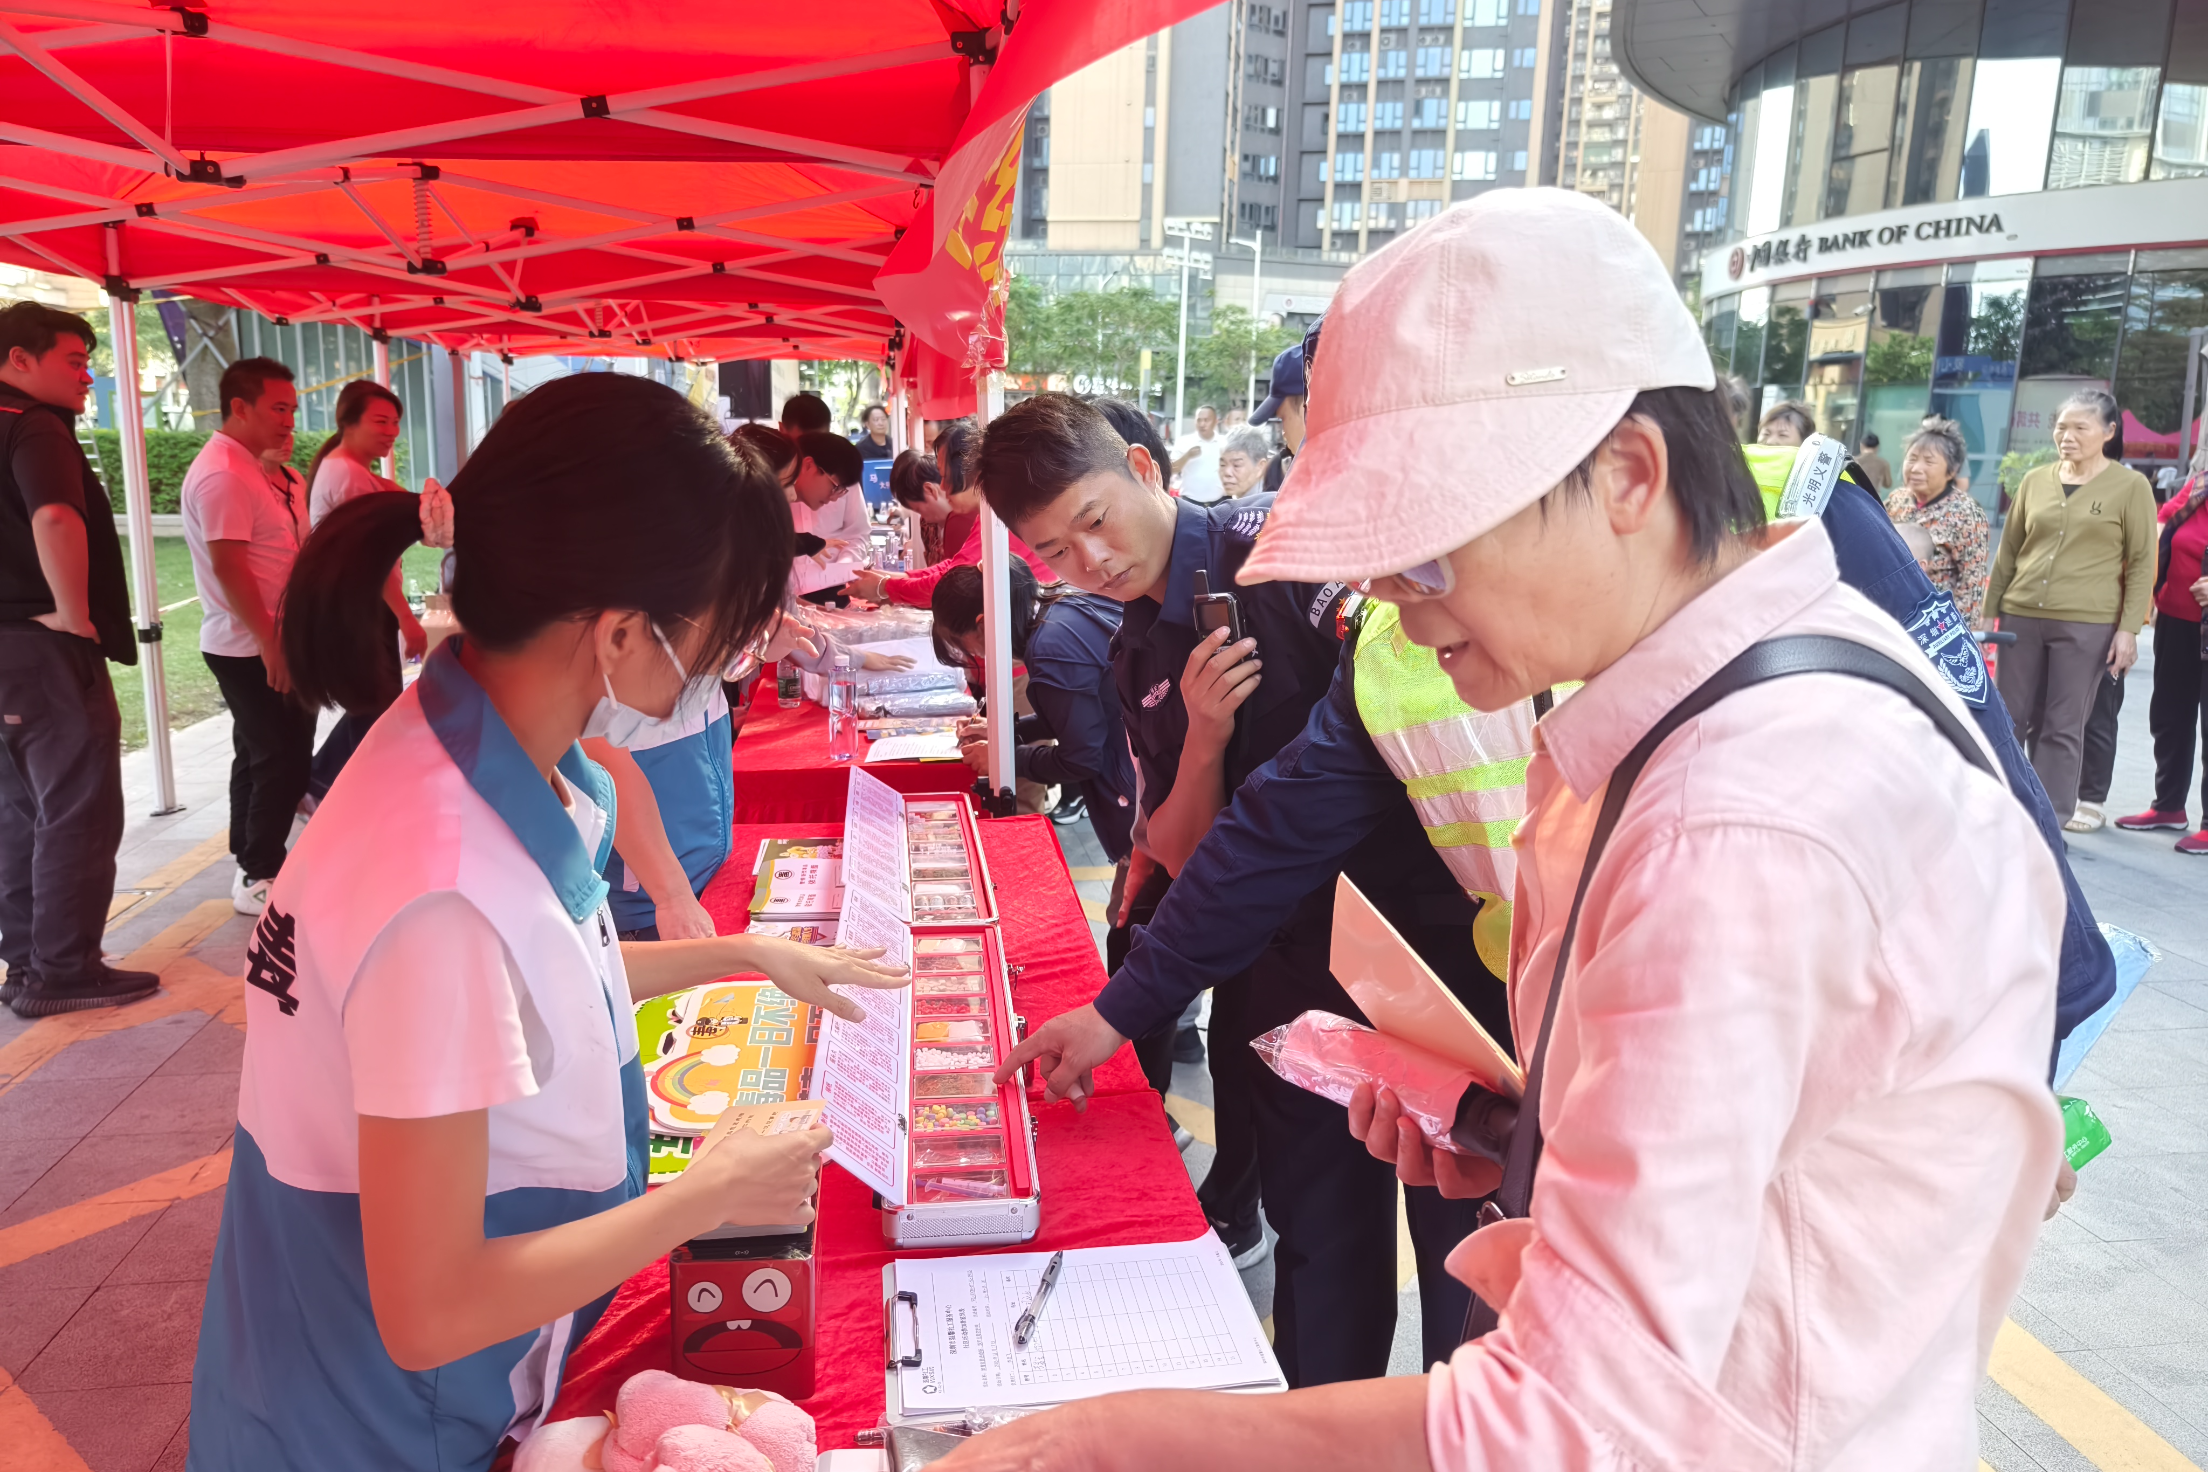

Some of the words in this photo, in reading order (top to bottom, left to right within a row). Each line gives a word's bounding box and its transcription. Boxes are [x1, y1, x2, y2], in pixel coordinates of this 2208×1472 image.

[1750, 233, 1812, 272] 中国银行
[1818, 228, 1873, 255] BANK
[1877, 223, 1909, 246] OF
[1914, 213, 2006, 242] CHINA
[1803, 450, 1832, 508] 光明义警
